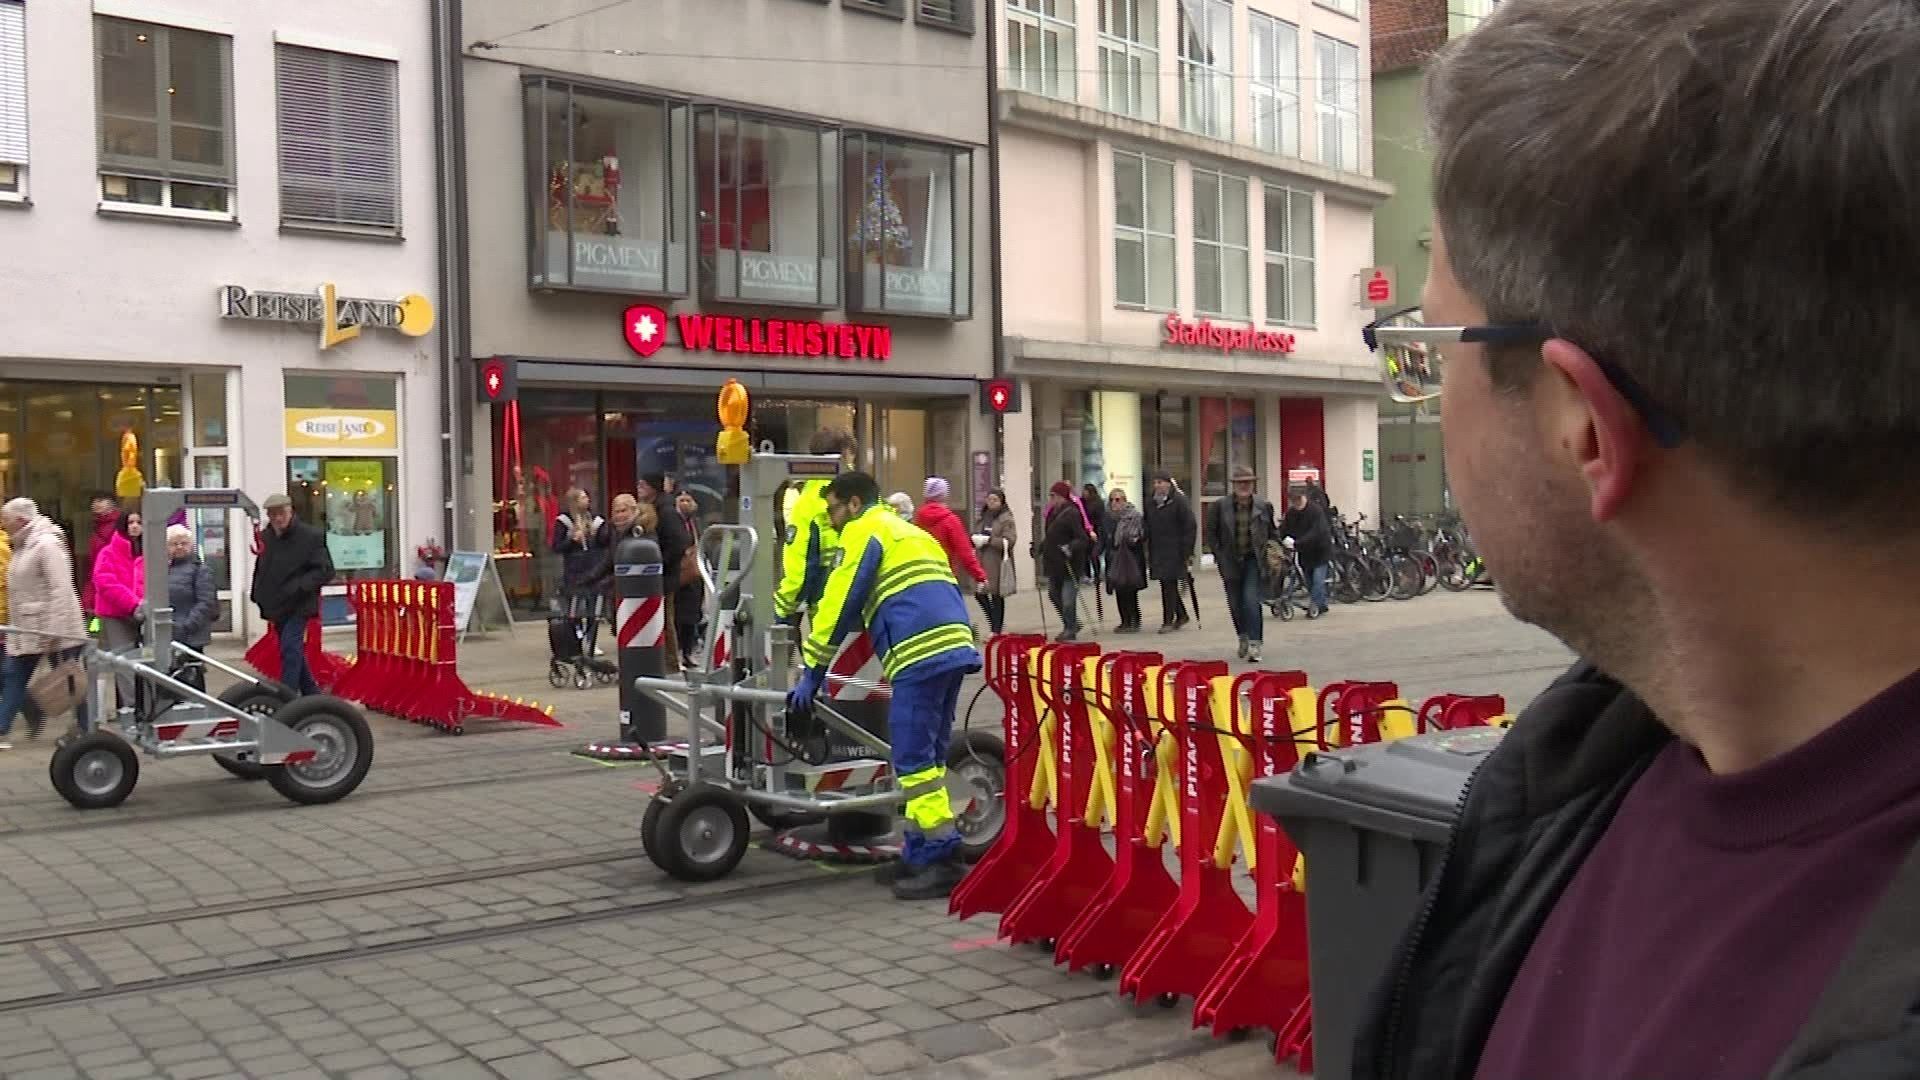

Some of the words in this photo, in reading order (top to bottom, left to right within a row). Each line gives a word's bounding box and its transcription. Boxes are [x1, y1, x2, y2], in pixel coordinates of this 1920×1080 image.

[576, 241, 659, 268] PIGMENT
[742, 257, 814, 284] PIGMENT
[886, 270, 947, 296] PIGMENT
[678, 313, 891, 361] WELLENSTEYN
[1166, 311, 1296, 358] Stadtsparkasse
[1010, 653, 1019, 748] PITAONE
[1123, 672, 1133, 777] PITAONE
